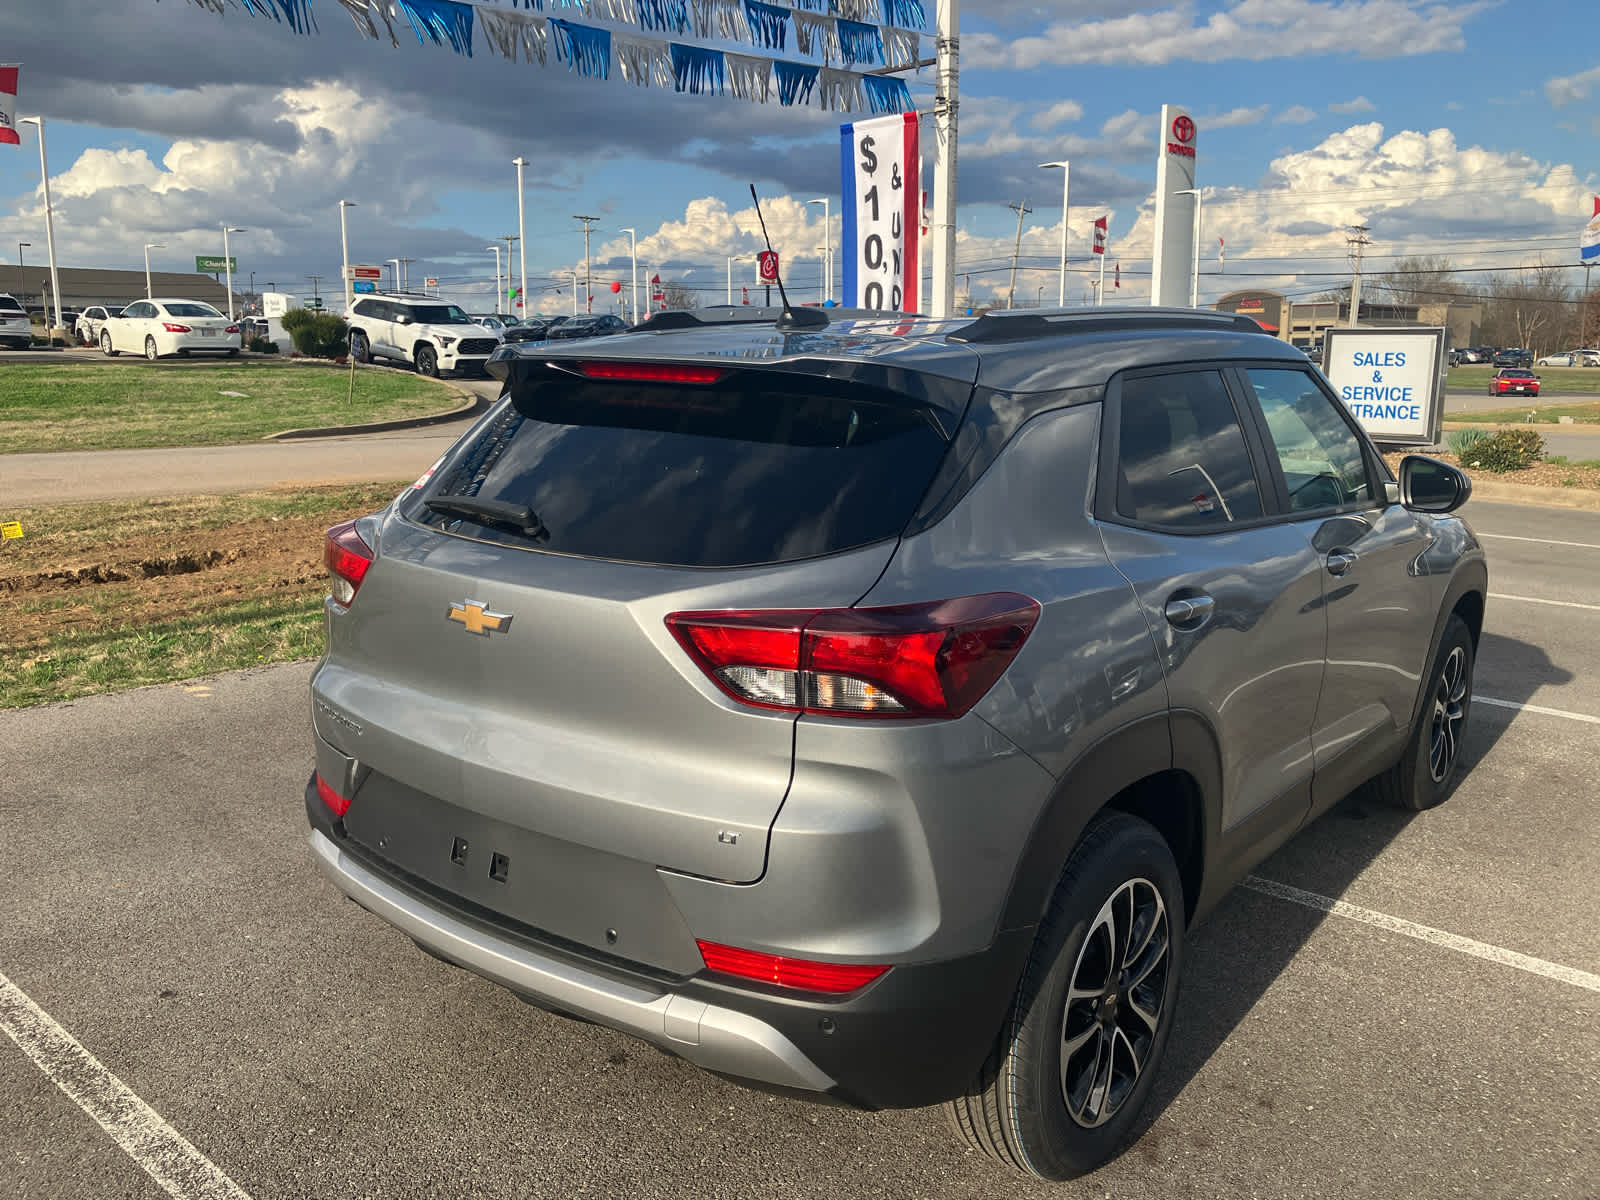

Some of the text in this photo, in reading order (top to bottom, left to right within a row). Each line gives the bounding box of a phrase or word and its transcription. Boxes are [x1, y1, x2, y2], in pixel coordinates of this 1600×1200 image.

[892, 162, 902, 191] &
[1353, 352, 1406, 367] SALES
[1372, 370, 1383, 383] &
[1342, 386, 1413, 402] SERVICE
[1350, 404, 1421, 420] TRANCE
[718, 830, 738, 845] LT
